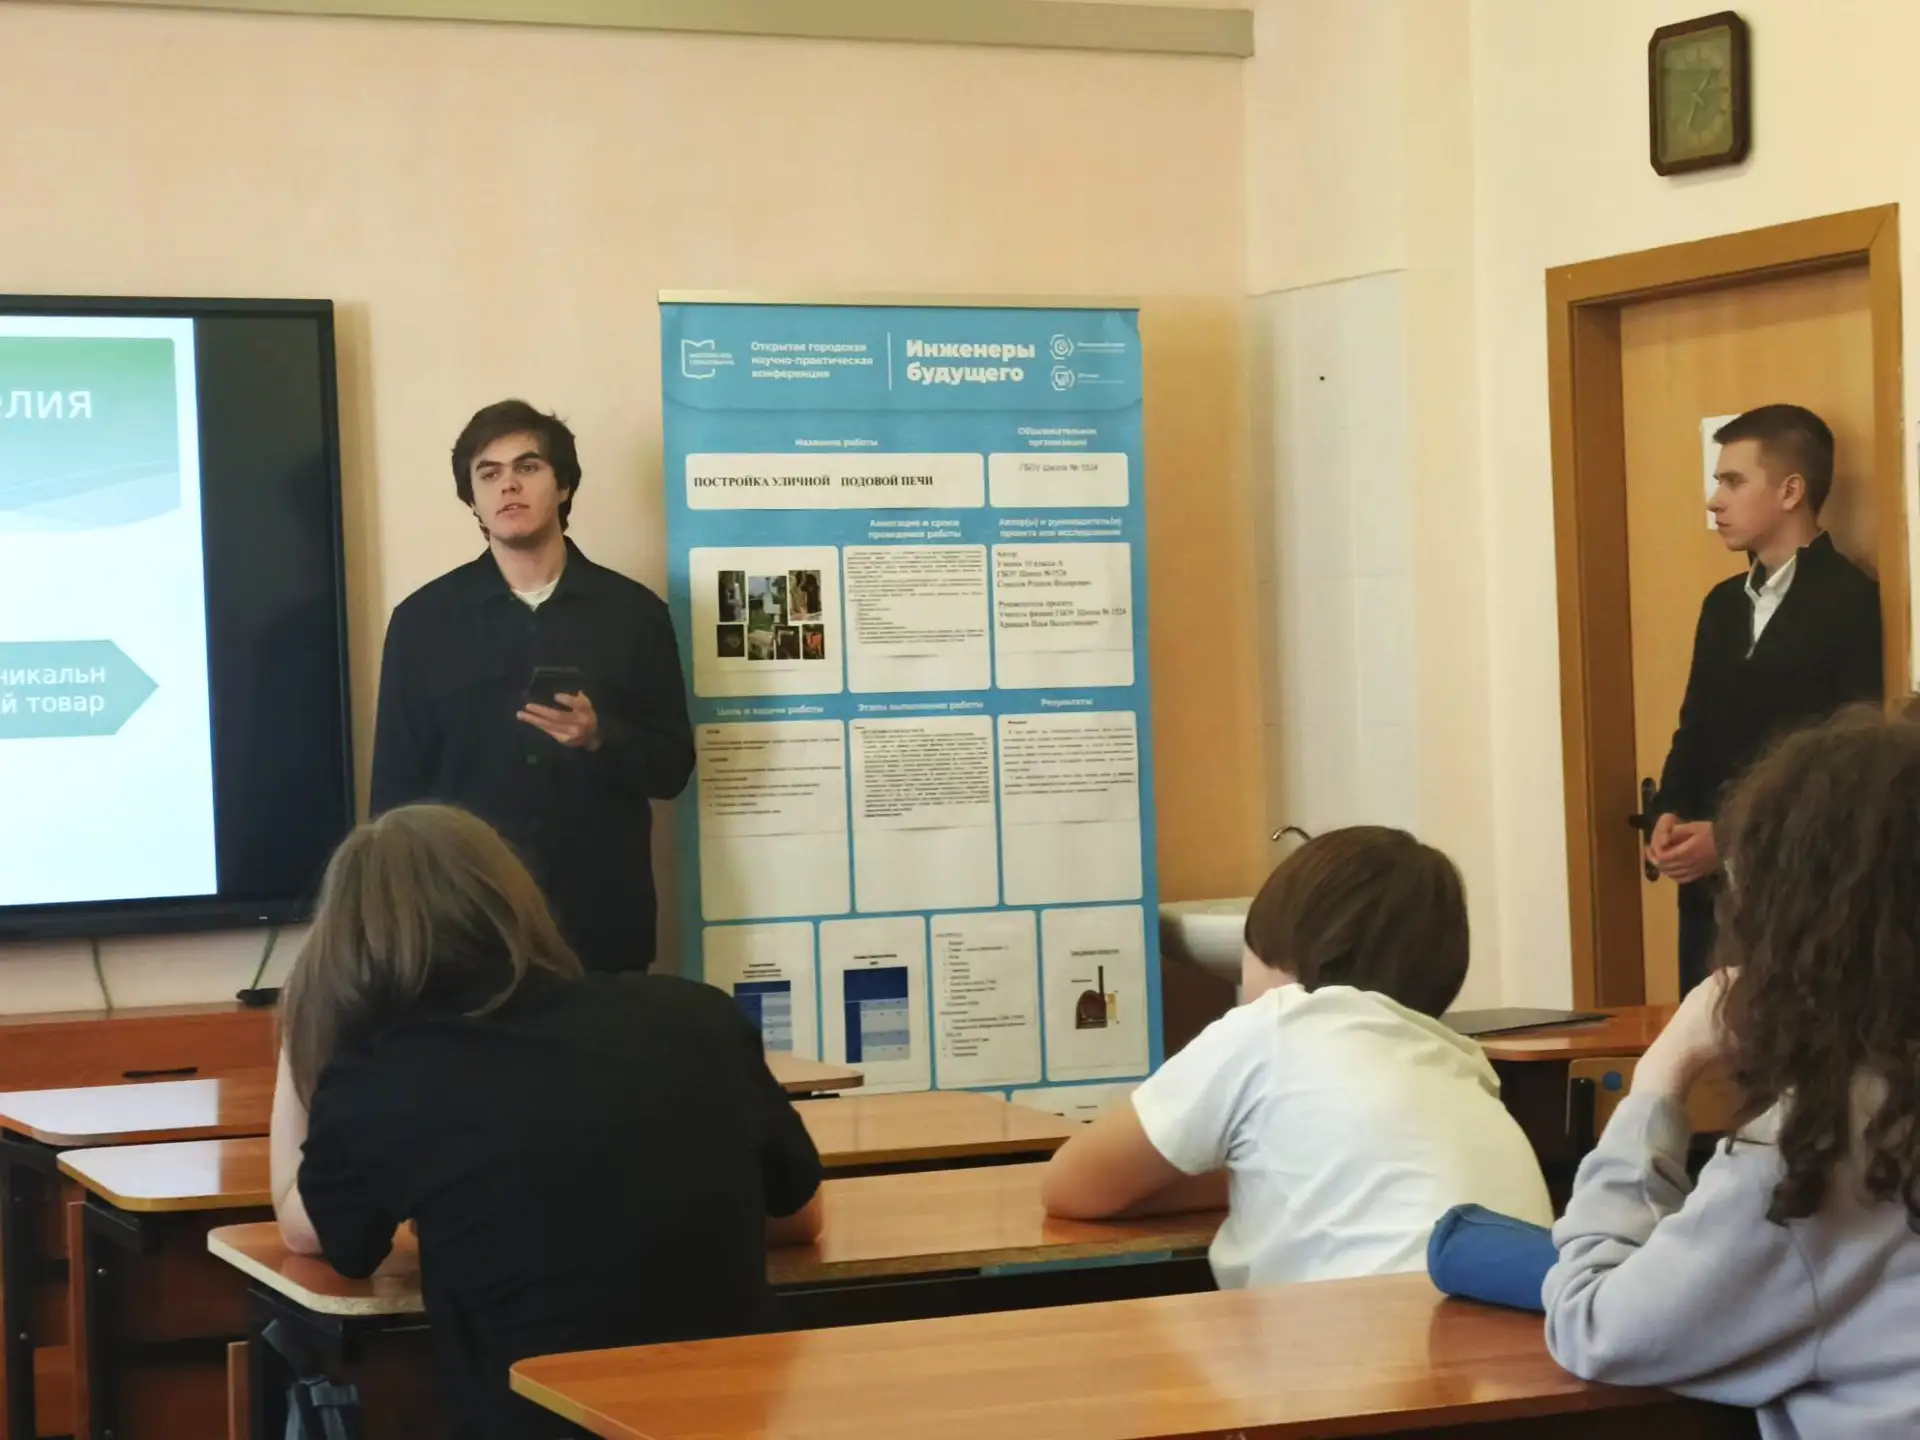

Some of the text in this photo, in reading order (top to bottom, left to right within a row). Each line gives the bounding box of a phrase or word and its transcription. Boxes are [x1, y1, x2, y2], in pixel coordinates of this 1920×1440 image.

[751, 341, 867, 353] Открытая городская
[906, 339, 1036, 362] Инженеры
[751, 354, 874, 366] научно-практическая
[751, 368, 831, 380] конференция
[906, 361, 1025, 385] будущего
[0, 390, 92, 419] лия
[694, 474, 934, 488] ПОСТРОЙКА УЛИЧНОЙ ПОДОВОЙ ПЕЧИ
[26, 694, 105, 717] товар
